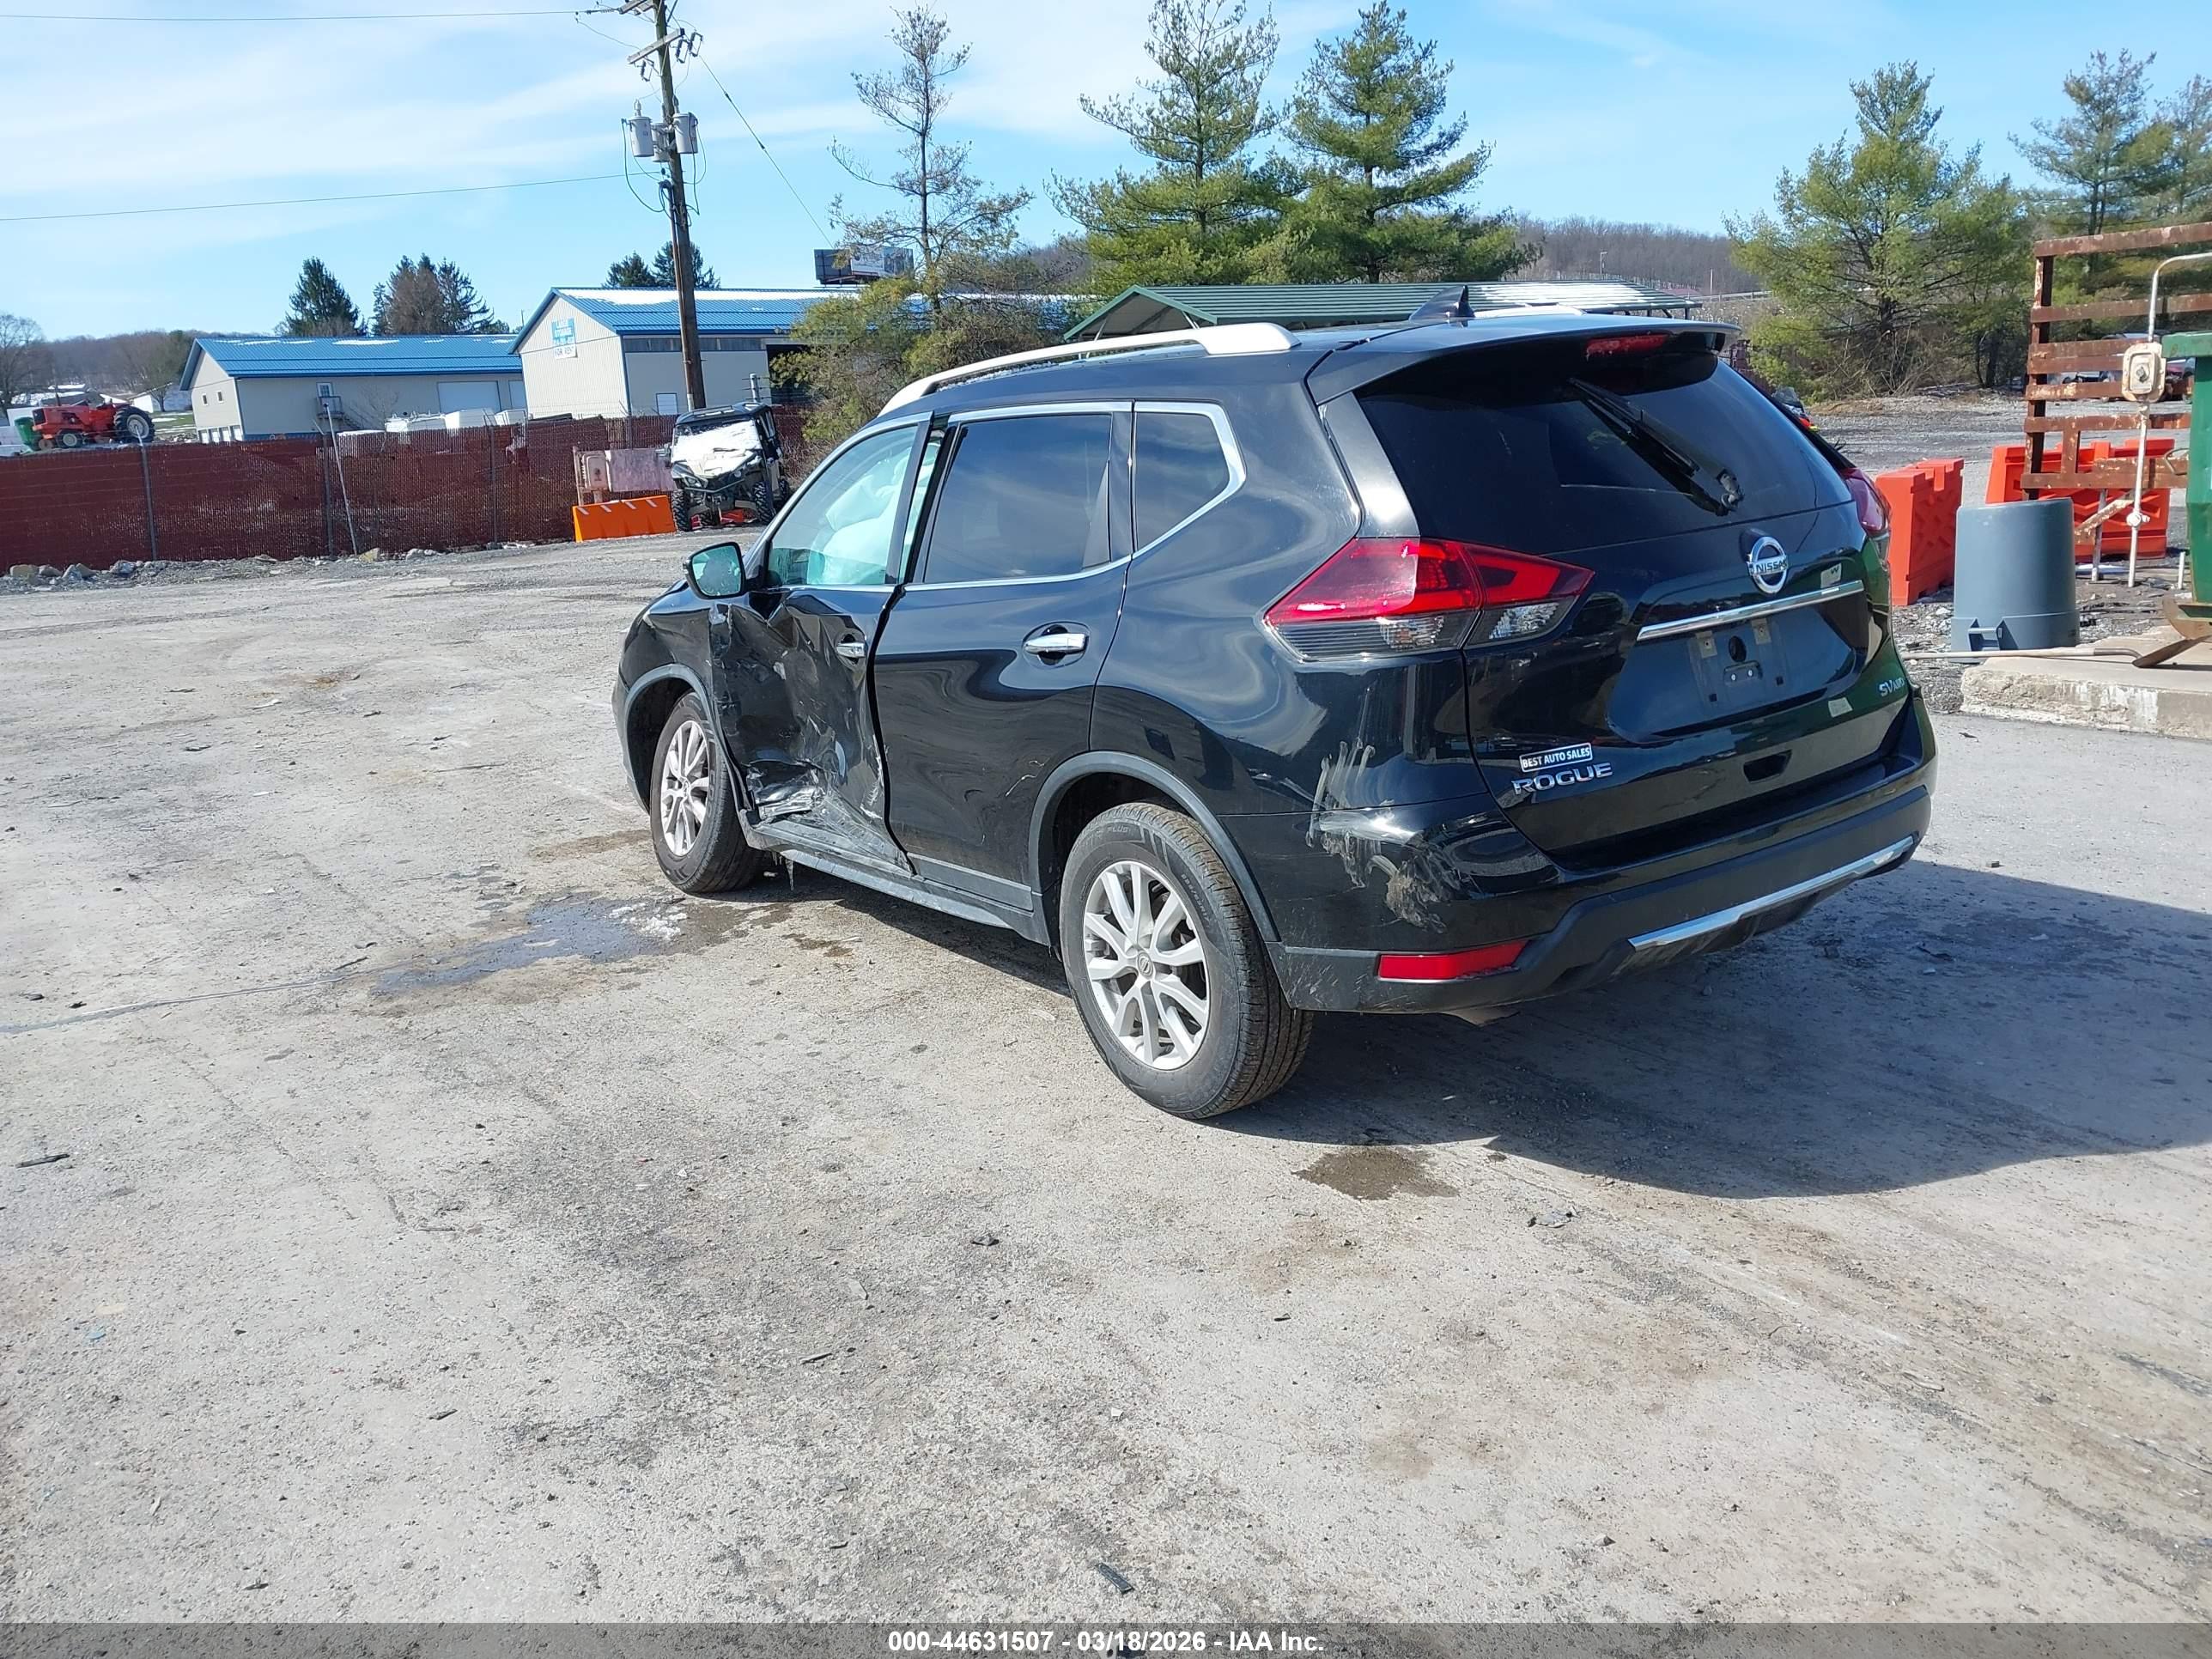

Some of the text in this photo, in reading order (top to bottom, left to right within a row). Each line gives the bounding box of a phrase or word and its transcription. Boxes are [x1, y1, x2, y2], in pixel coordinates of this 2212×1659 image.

[1522, 746, 1590, 769] BEST AUTO SALES
[1511, 762, 1613, 795] ROGUE
